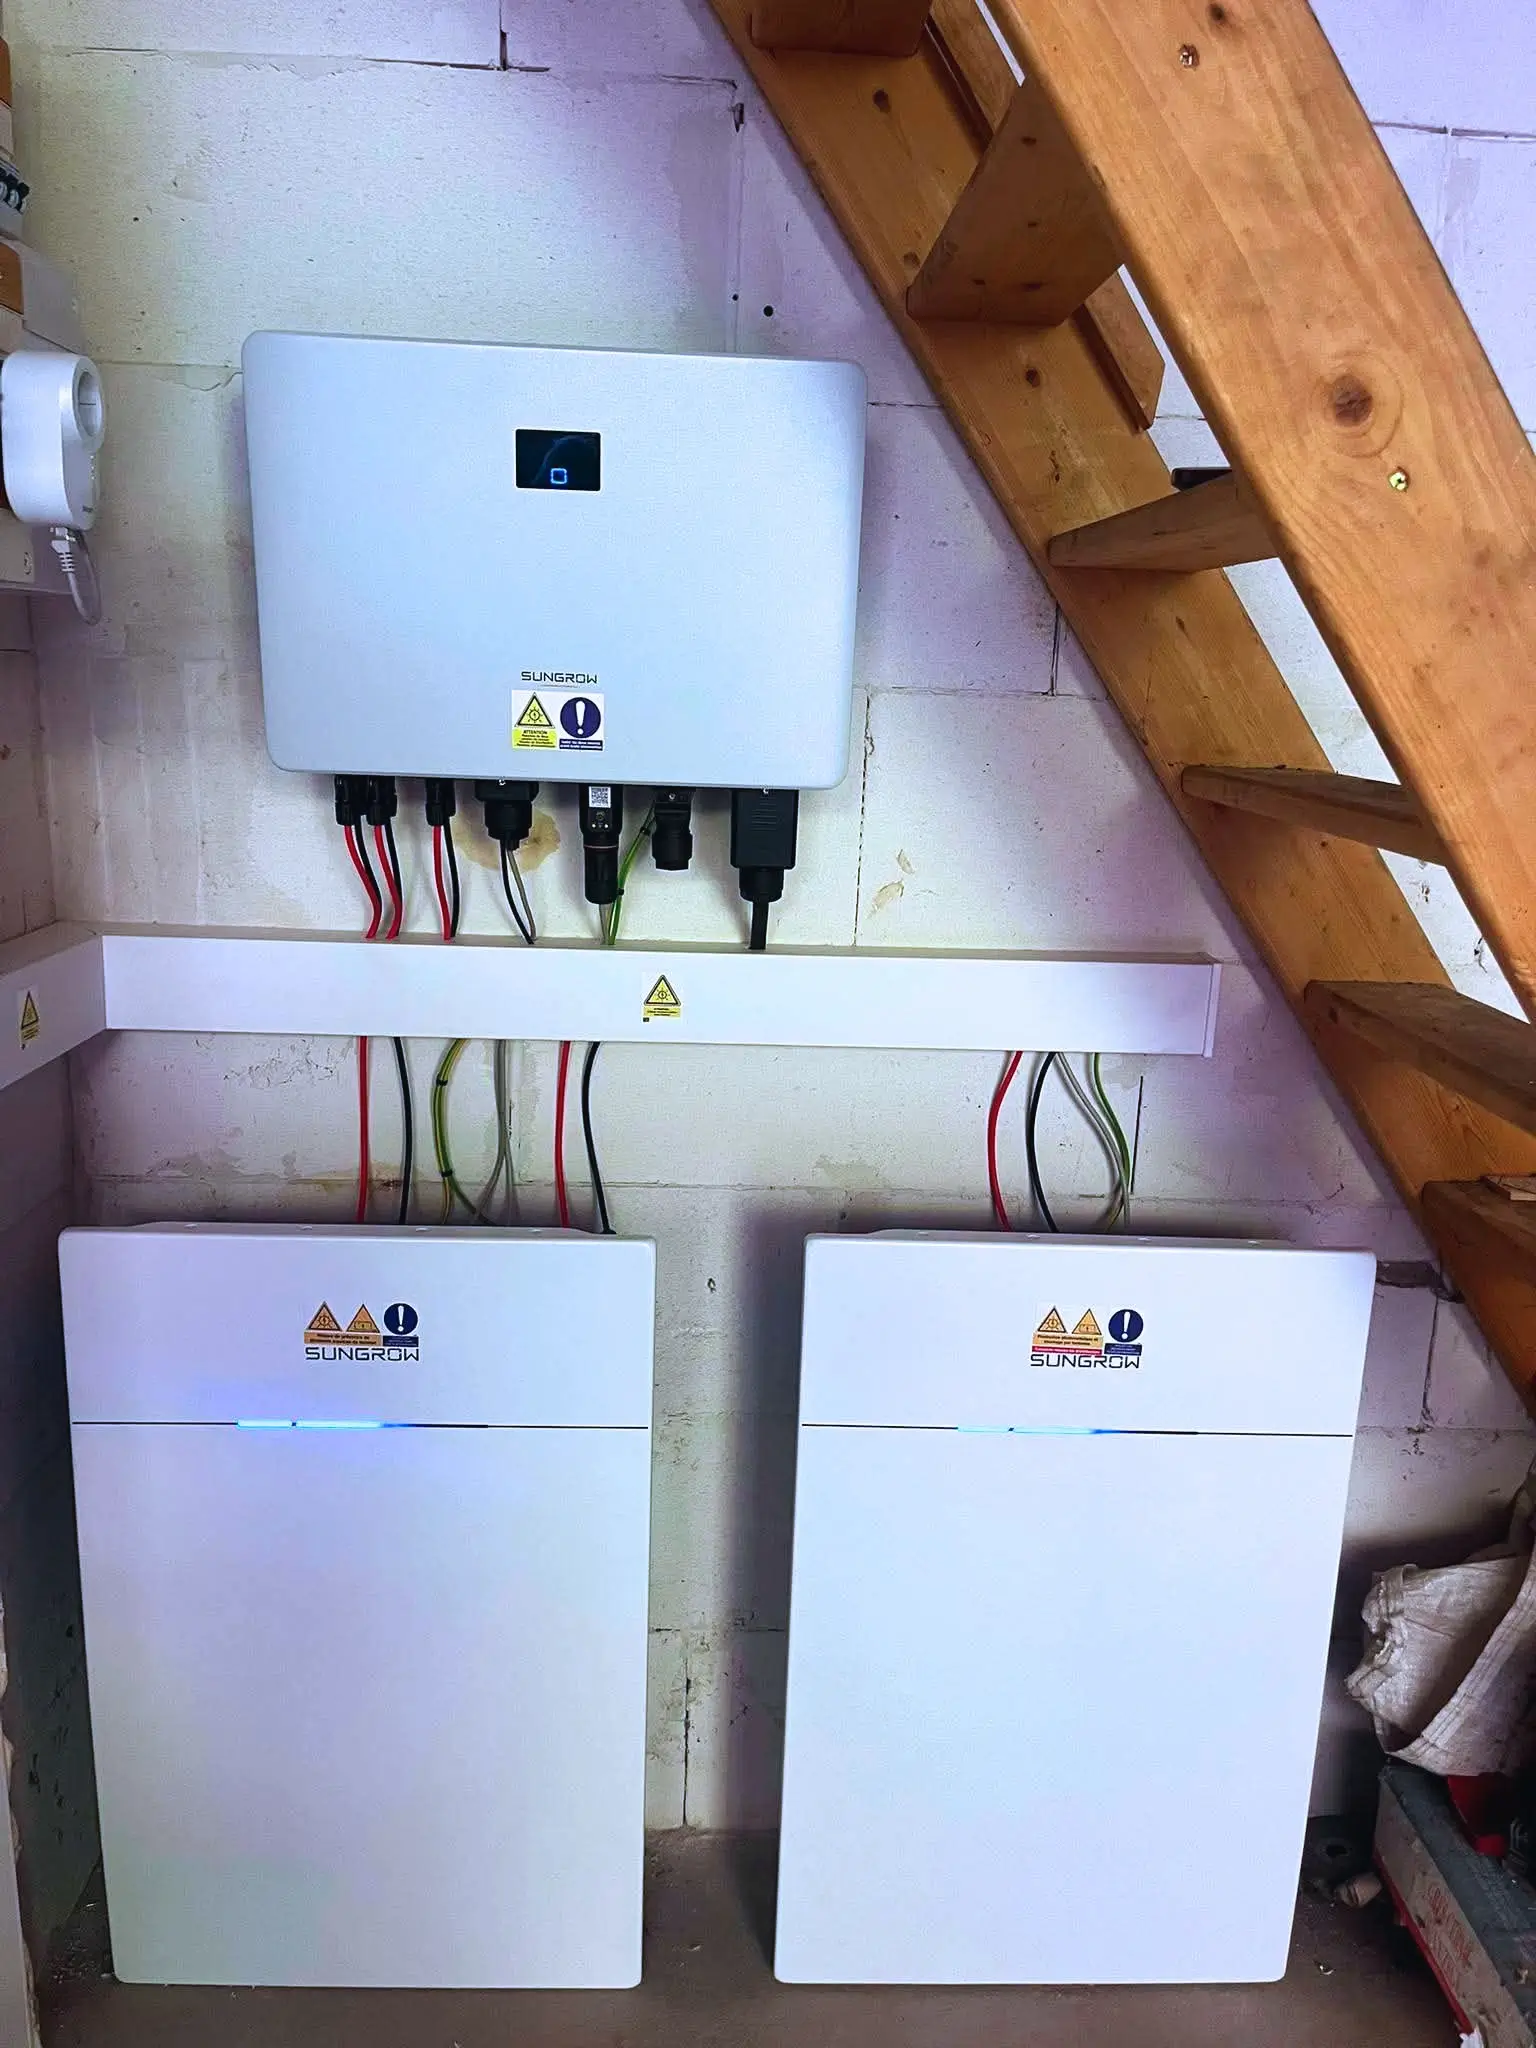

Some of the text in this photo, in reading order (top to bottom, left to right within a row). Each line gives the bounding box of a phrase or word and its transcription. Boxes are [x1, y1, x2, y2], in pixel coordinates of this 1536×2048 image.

[521, 671, 597, 684] SUNGROW
[305, 1347, 419, 1361] SUNGROW
[1030, 1354, 1139, 1368] SUNGROW
